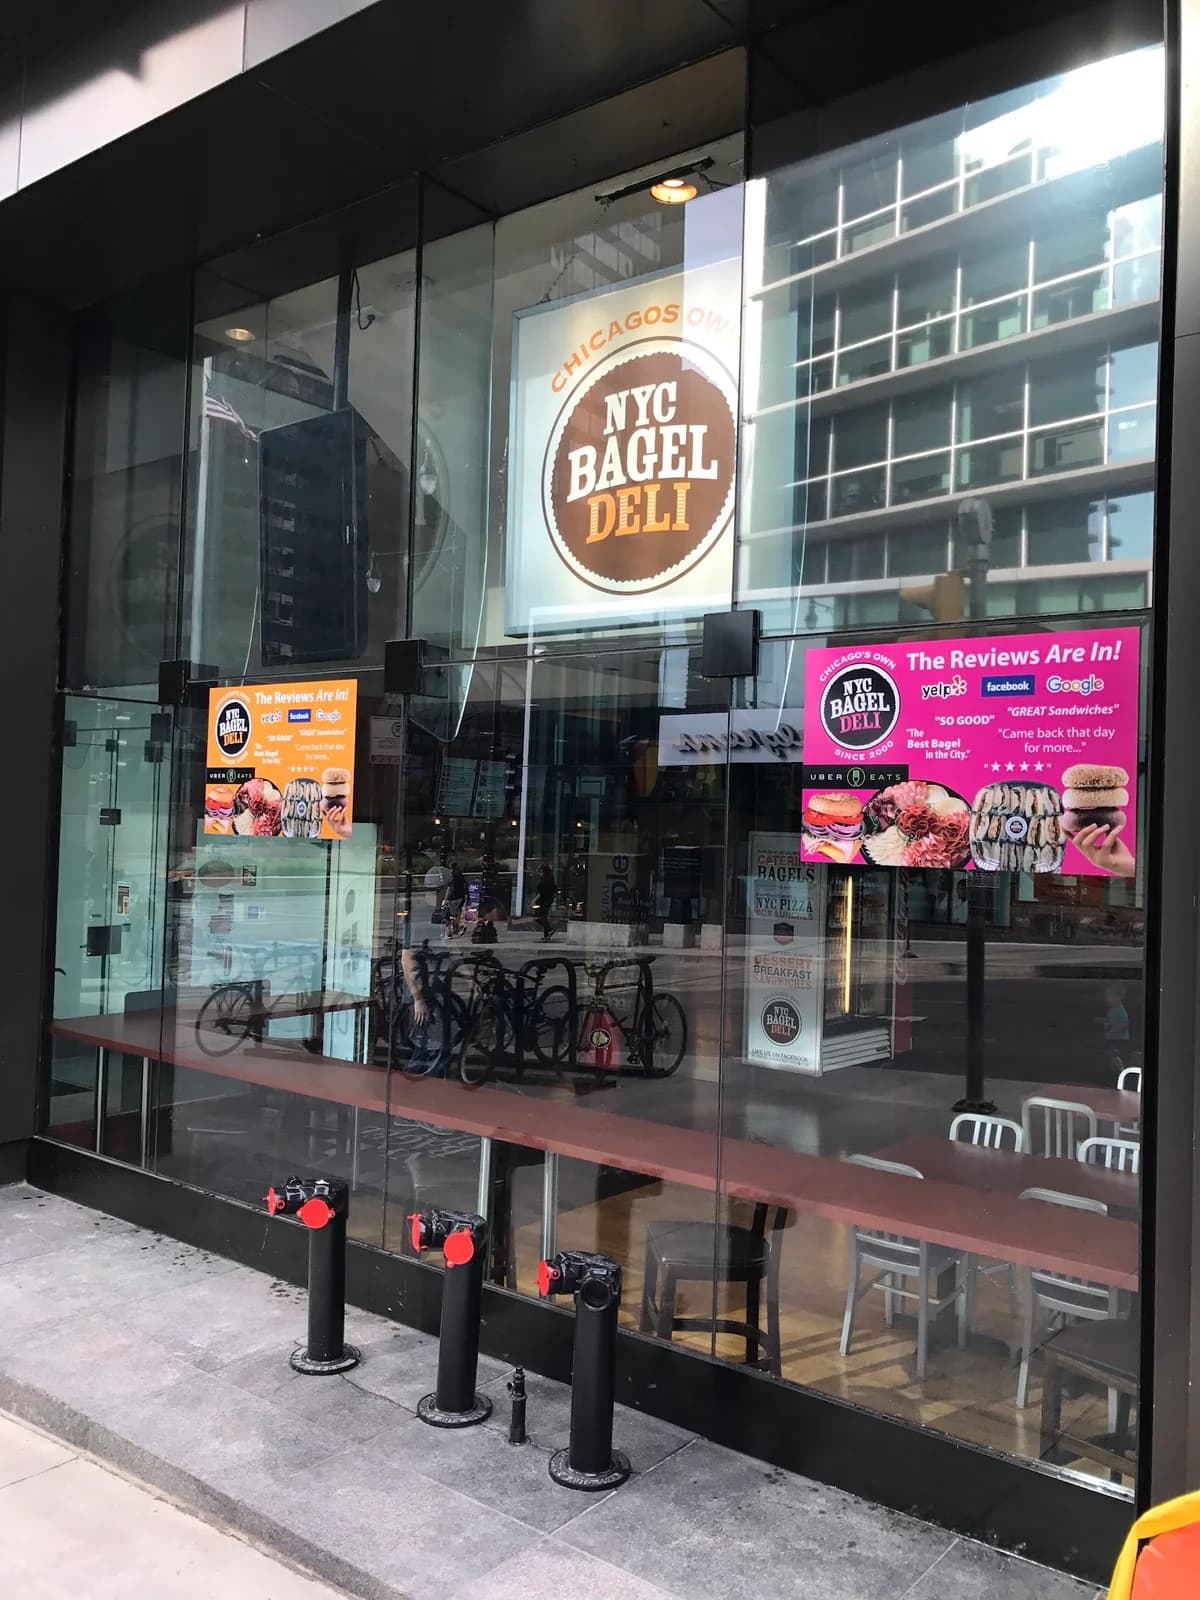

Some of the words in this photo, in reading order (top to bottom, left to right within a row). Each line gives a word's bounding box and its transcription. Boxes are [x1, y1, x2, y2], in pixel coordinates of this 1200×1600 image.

[550, 304, 681, 393] CHICAGOS
[603, 381, 678, 436] NYC
[567, 424, 719, 503] BAGEL
[585, 481, 692, 545] DELI
[907, 651, 945, 671] The
[951, 648, 1040, 668] Reviews
[1045, 644, 1086, 664] Are
[1090, 641, 1123, 662] In!
[819, 651, 872, 682] CHICAGO'S
[873, 652, 897, 670] OWN
[843, 677, 872, 696] NYC
[922, 682, 952, 699] yelp
[986, 681, 1030, 692] facebook
[1047, 674, 1104, 695] Google
[255, 691, 273, 705] The
[274, 690, 314, 704] Reviews
[316, 688, 334, 702] Are
[335, 687, 350, 701] In!
[829, 692, 891, 719] BAGEL
[1007, 706, 1047, 718] "GREAT
[1048, 703, 1121, 717] Sandwiches"
[225, 708, 240, 720] NYC
[935, 716, 955, 726] "SO
[956, 715, 995, 726] GOOD"
[219, 718, 248, 736] BAGEL
[840, 711, 881, 734] DELI
[224, 731, 244, 747] DELI
[906, 728, 925, 738] "The
[998, 728, 1035, 740] "Came
[1036, 728, 1065, 739] back
[1066, 727, 1091, 739] that
[1093, 726, 1116, 740] day
[834, 748, 866, 761] SINCE
[868, 740, 895, 759] 2000
[907, 739, 929, 749] Best
[931, 738, 961, 751] Bagel
[1023, 743, 1041, 753] for
[925, 750, 935, 759] in
[936, 749, 949, 759] the
[870, 773, 901, 781] EATS
[757, 865, 816, 883] BAGELS
[755, 897, 777, 909] NYC
[780, 897, 813, 913] PIZZA
[753, 965, 812, 980] BREAKFAST
[774, 1006, 789, 1016] NYC
[766, 1014, 797, 1029] BAGEL
[771, 1024, 792, 1037] DELI
